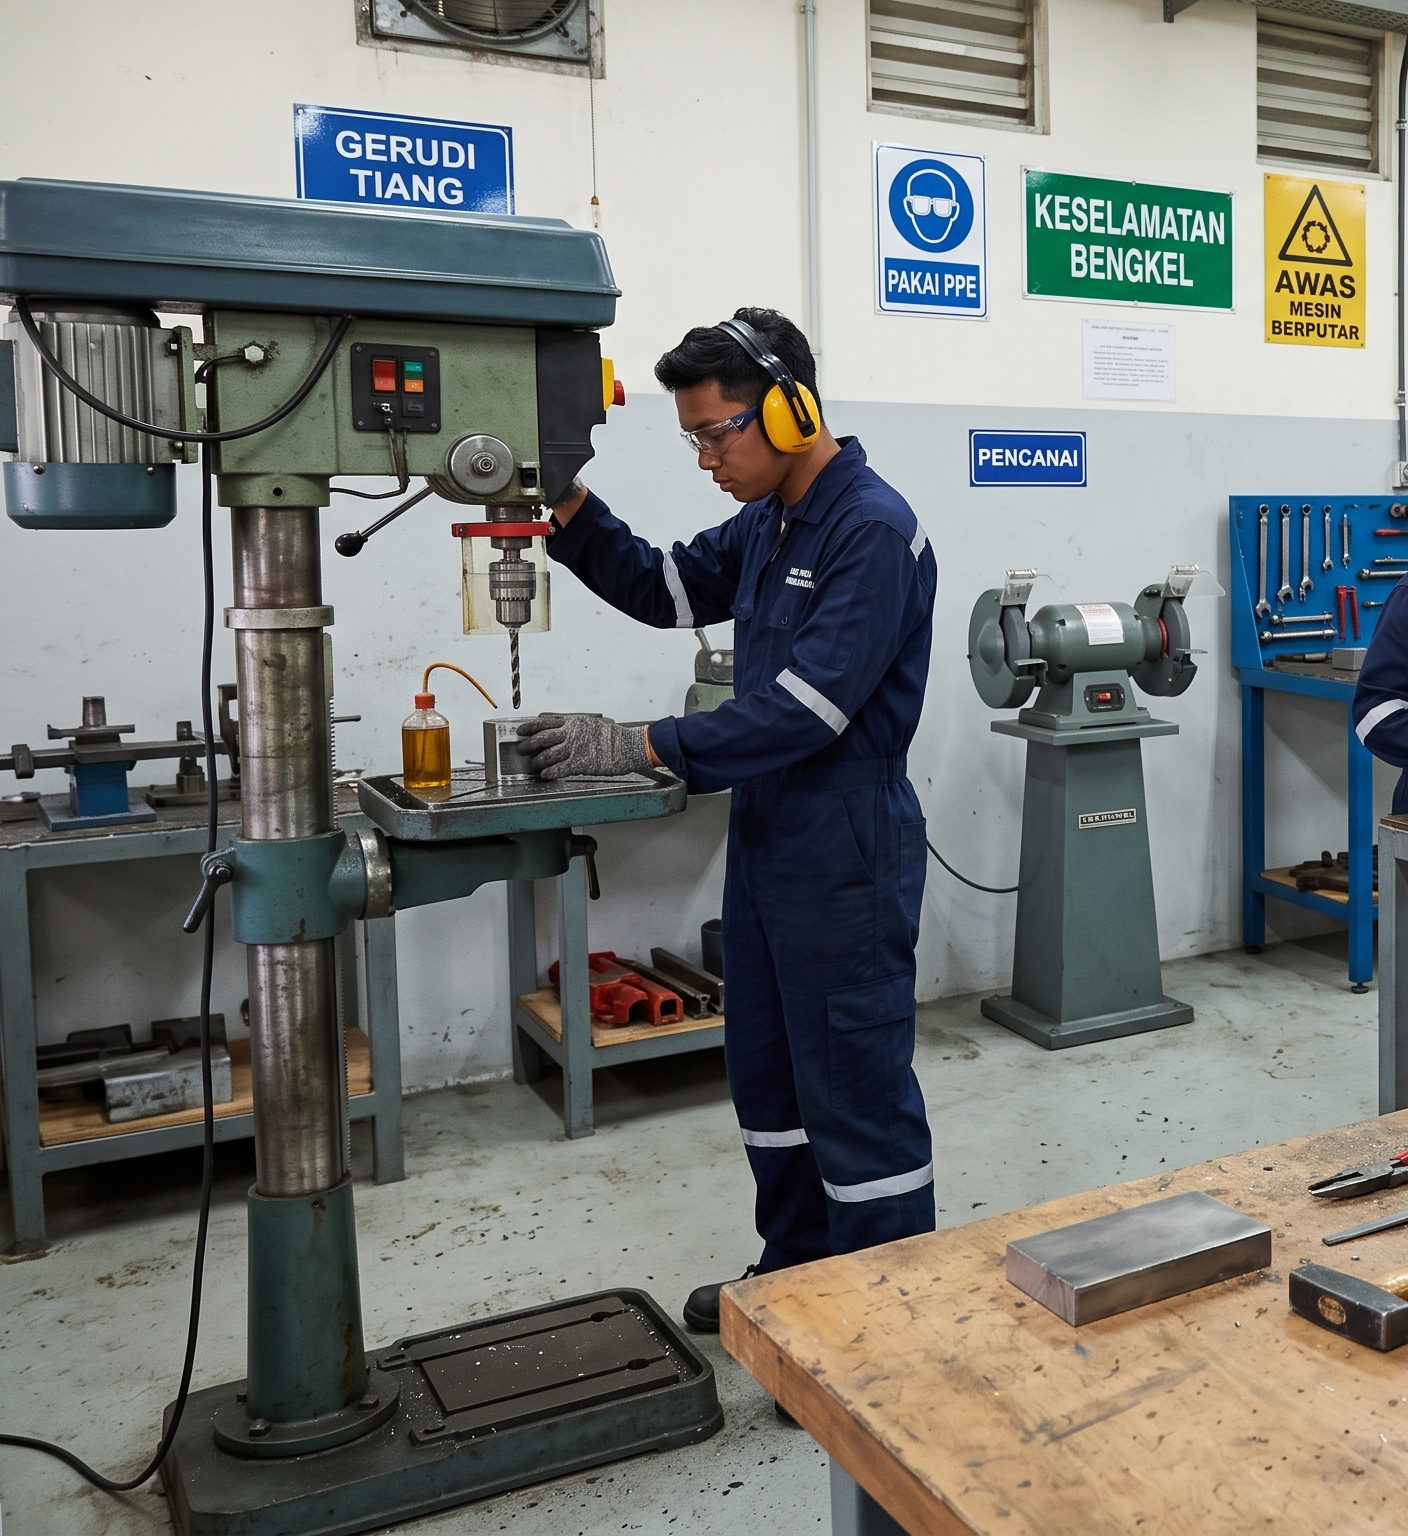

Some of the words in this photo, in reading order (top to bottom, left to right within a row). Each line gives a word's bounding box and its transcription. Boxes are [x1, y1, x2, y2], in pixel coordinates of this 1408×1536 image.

[335, 130, 476, 170] GERUDI
[349, 168, 464, 205] TIANG
[1034, 193, 1225, 245] KESELAMATAN
[1070, 243, 1194, 287] BENGKEL
[887, 269, 940, 296] PAKAI
[944, 273, 977, 298] PPE
[1274, 269, 1356, 299] AWAS
[1289, 300, 1342, 319] MESIN
[1271, 320, 1360, 340] BERPUTAR
[978, 448, 1078, 467] PENCANAI
